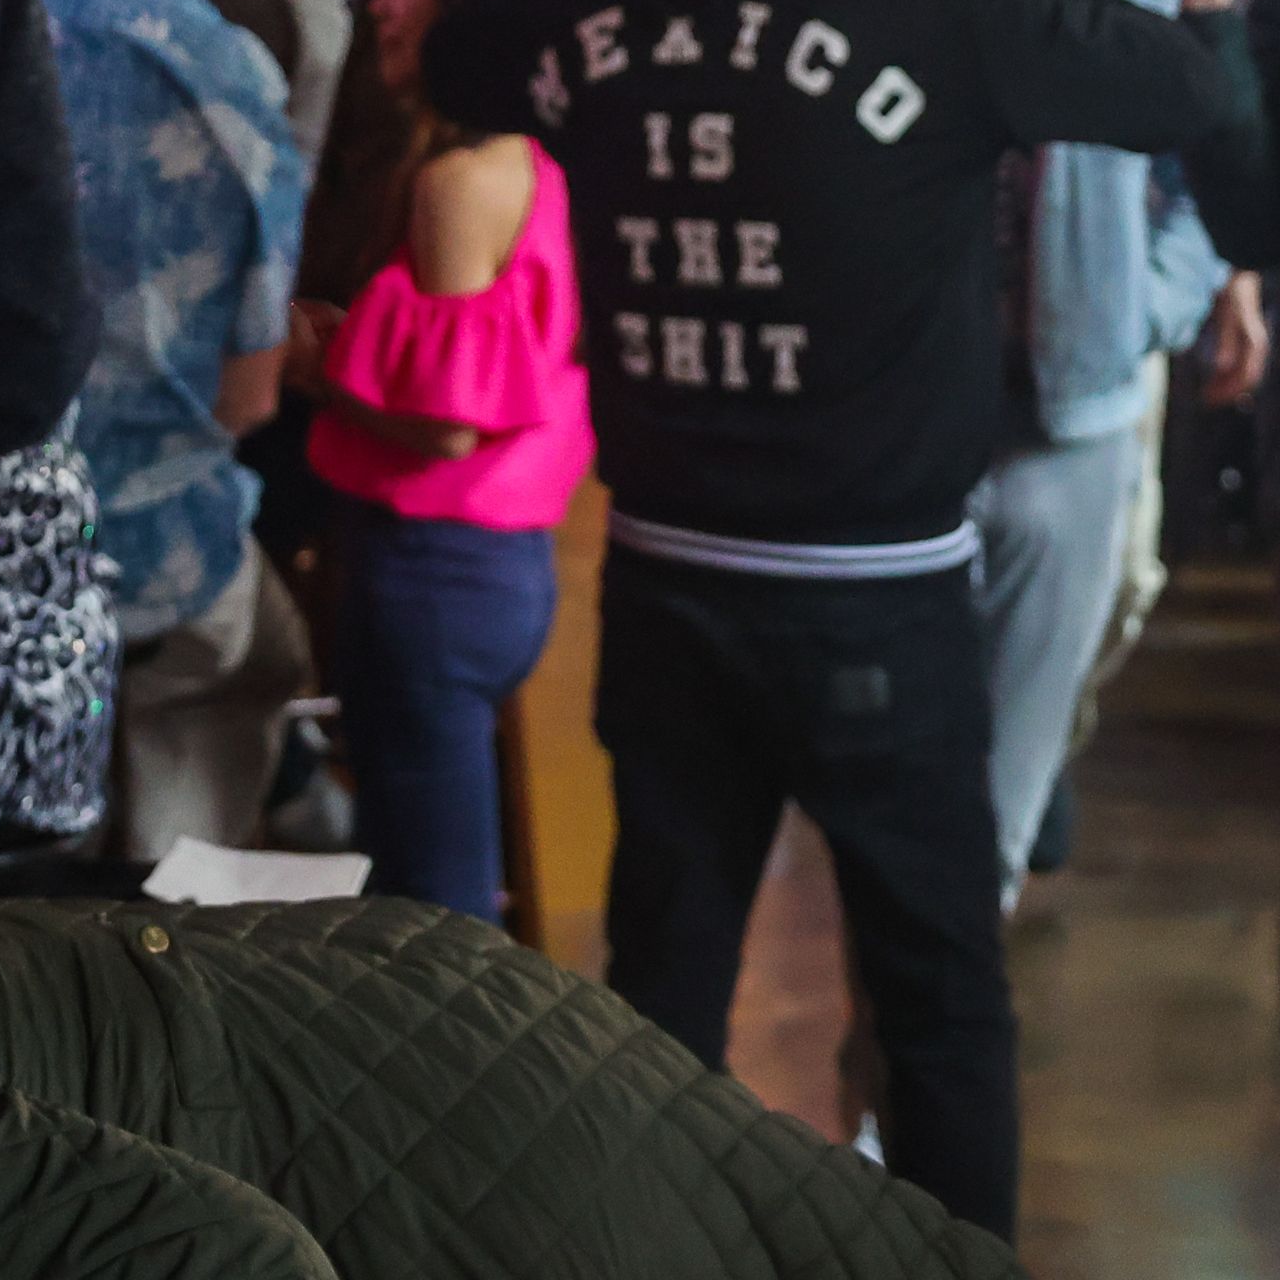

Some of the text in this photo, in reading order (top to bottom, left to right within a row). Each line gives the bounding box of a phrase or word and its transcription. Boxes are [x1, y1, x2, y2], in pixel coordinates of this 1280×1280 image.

[642, 110, 736, 183] IS
[615, 217, 784, 288] THE
[613, 312, 809, 394] SHIT
